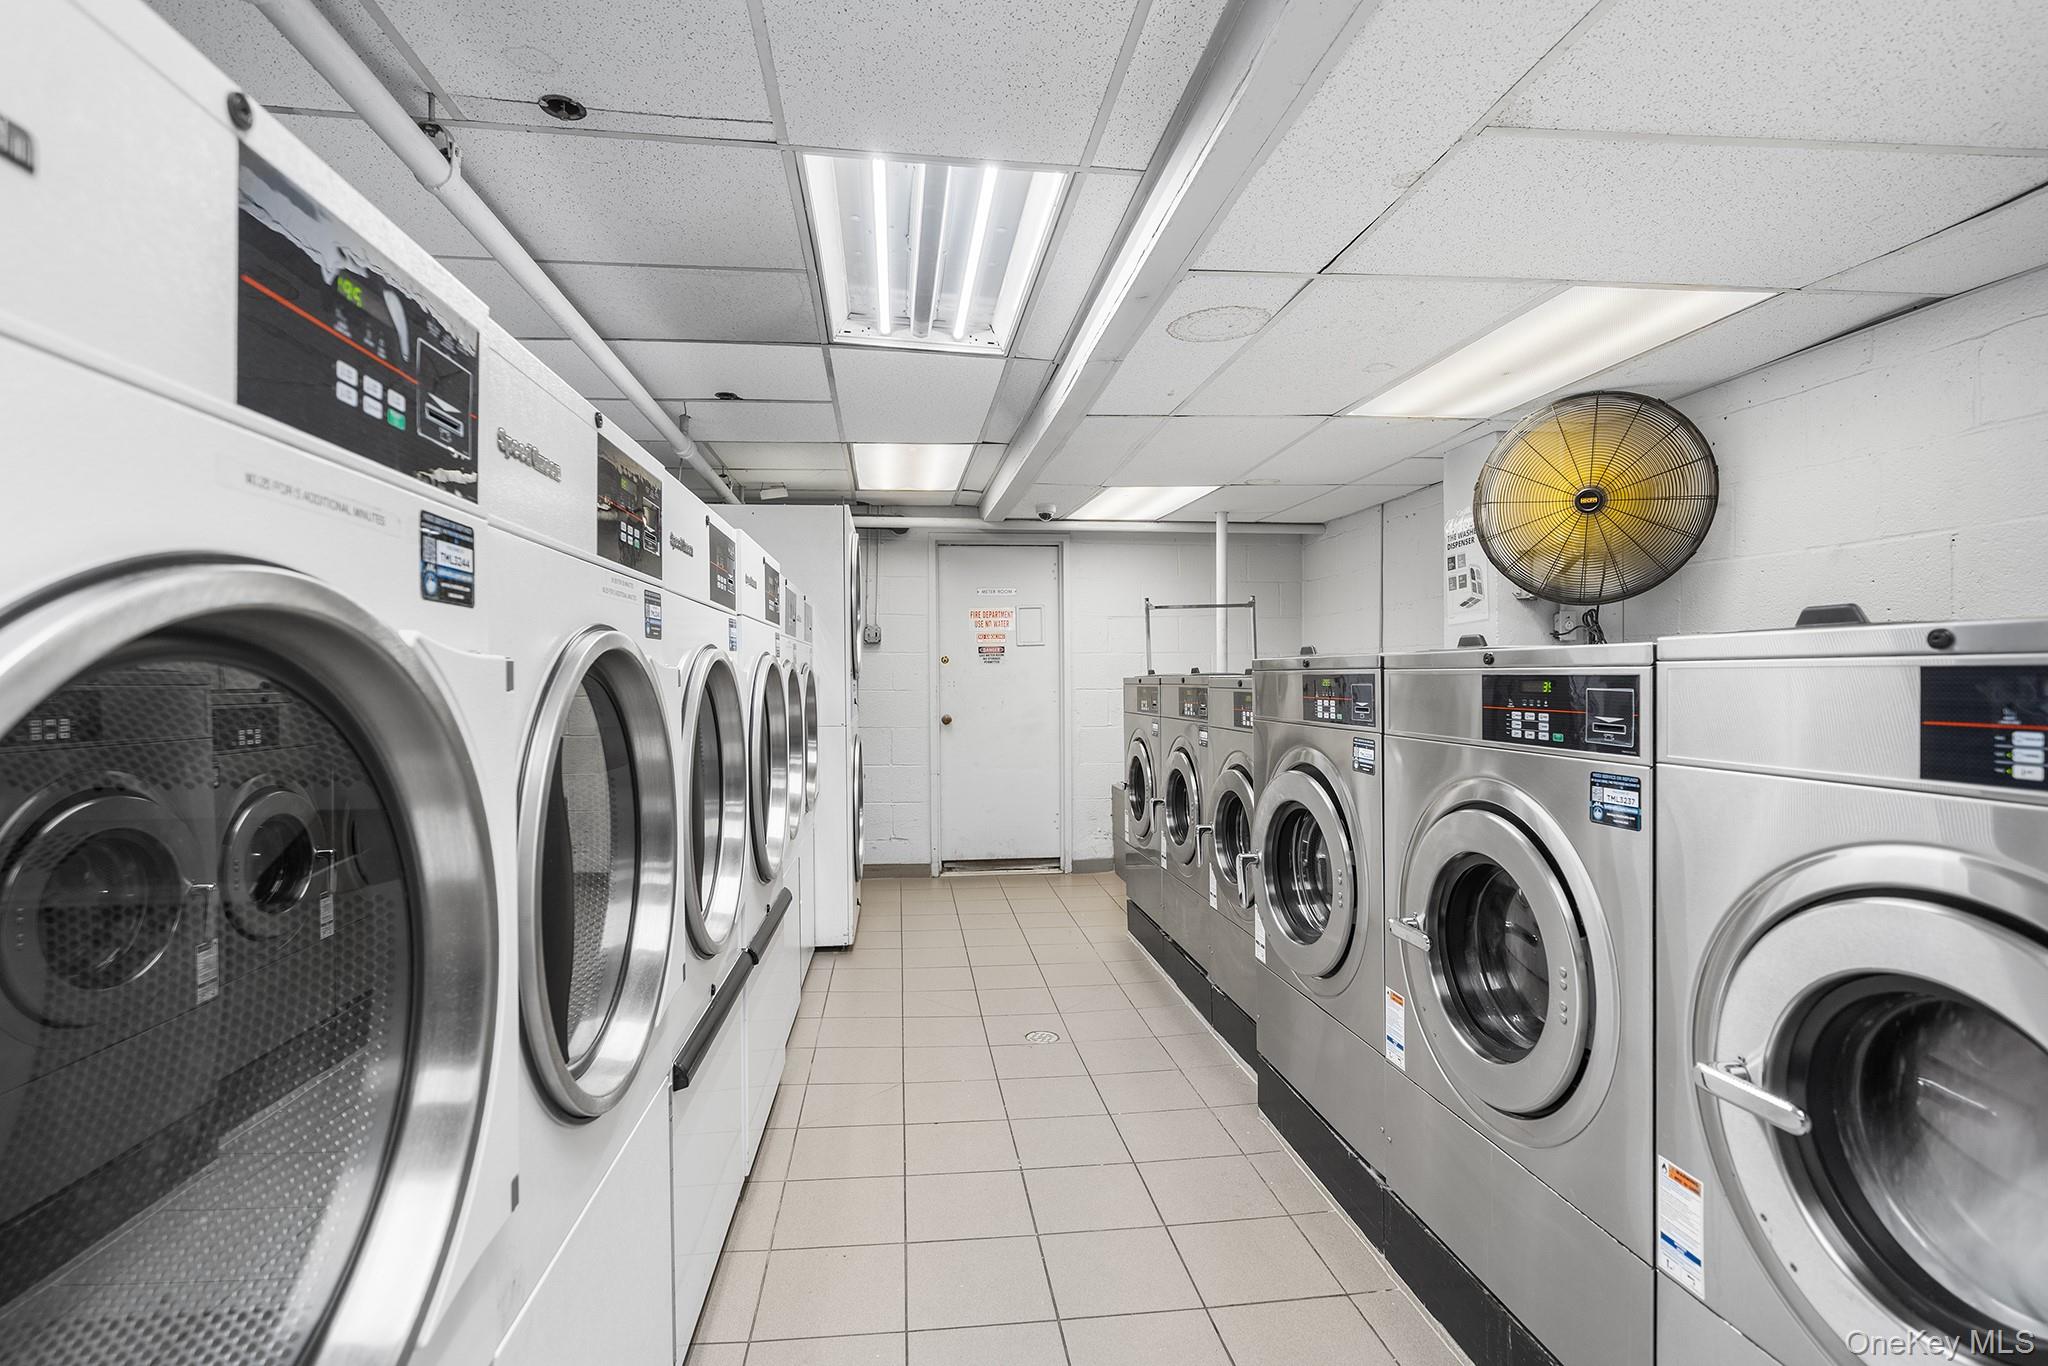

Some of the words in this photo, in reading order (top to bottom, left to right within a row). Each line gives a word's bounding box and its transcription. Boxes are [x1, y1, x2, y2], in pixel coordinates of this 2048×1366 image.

[1457, 527, 1478, 539] WASHE
[1447, 536, 1475, 551] DISPENSER
[970, 610, 982, 619] FIRE
[982, 610, 1014, 619] DEPARTMENT
[975, 619, 984, 628] USE
[985, 619, 993, 628] NO
[993, 619, 1009, 628] WATER
[1606, 794, 1636, 805] TML3237
